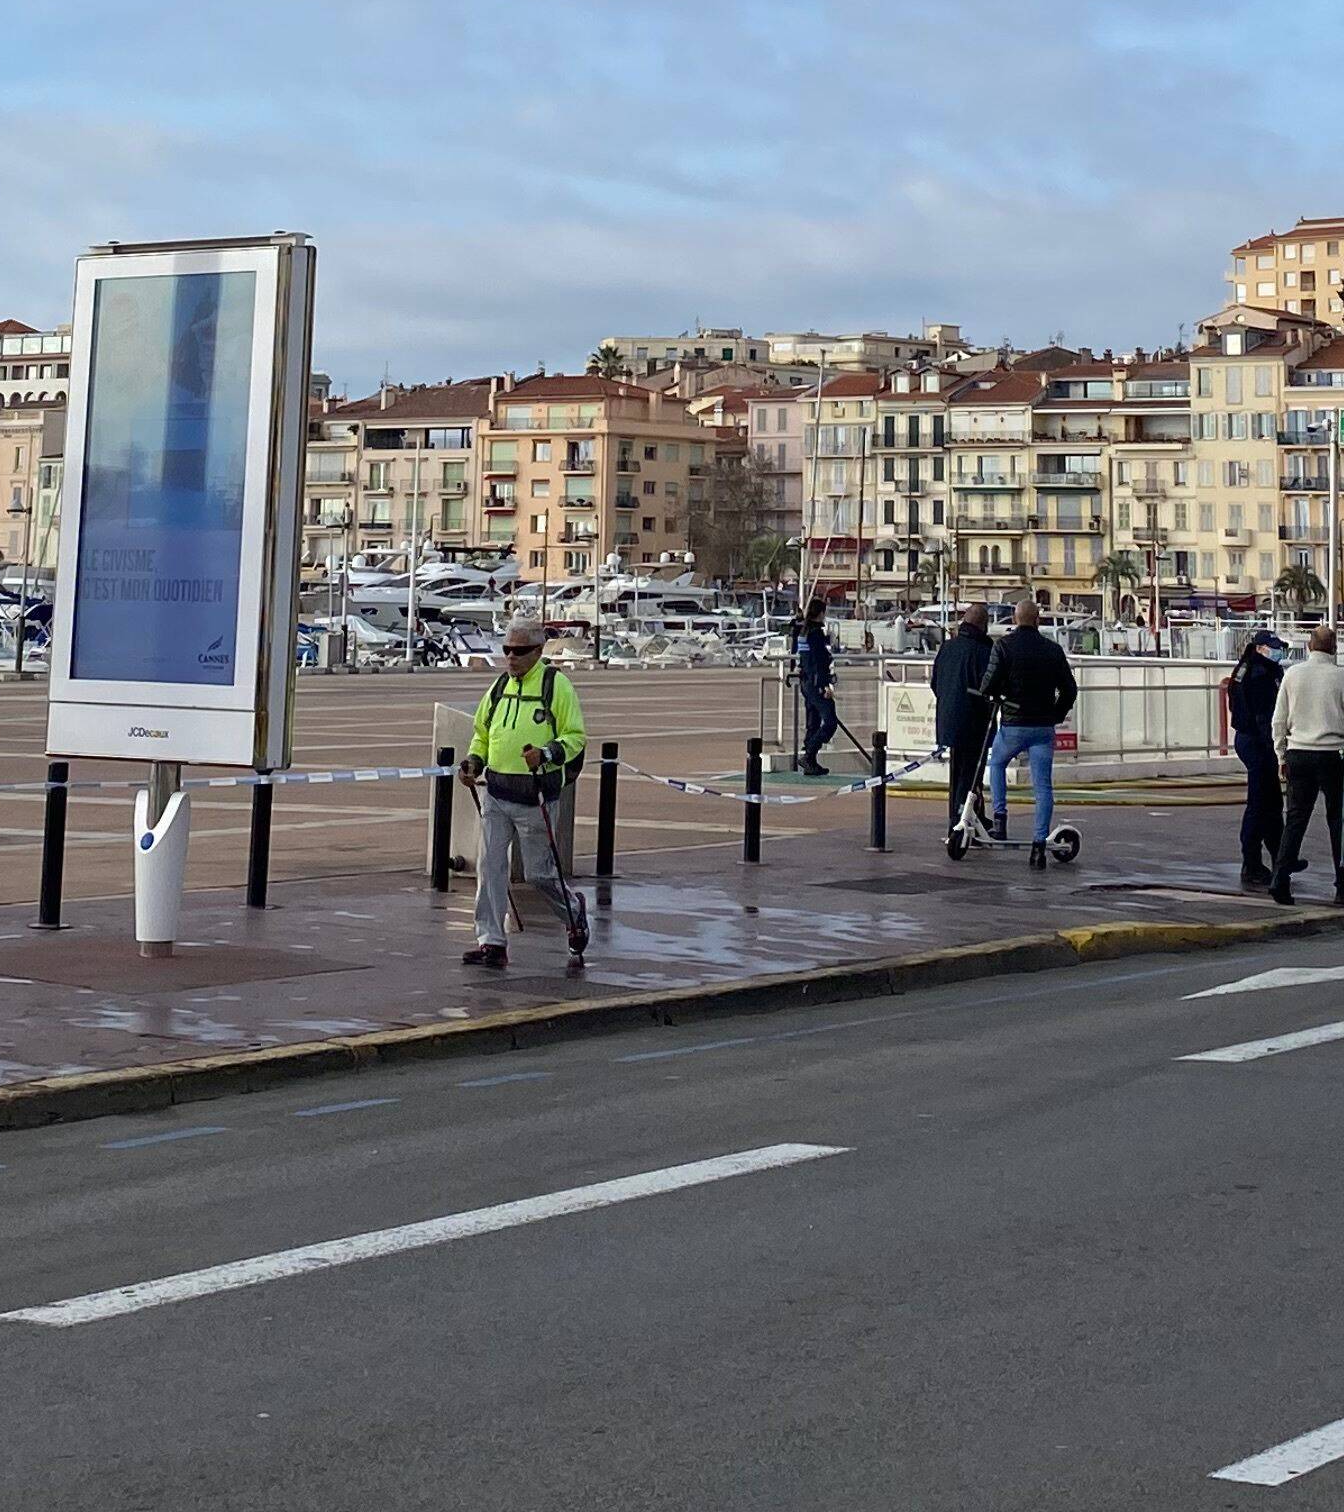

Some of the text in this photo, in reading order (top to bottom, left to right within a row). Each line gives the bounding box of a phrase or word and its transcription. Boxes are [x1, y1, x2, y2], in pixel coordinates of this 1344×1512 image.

[84, 549, 98, 571] LE
[120, 578, 150, 601] MON
[154, 579, 223, 603] QUOTIDIEN
[197, 653, 230, 664] CANNES
[128, 727, 170, 739] JCDecaux
